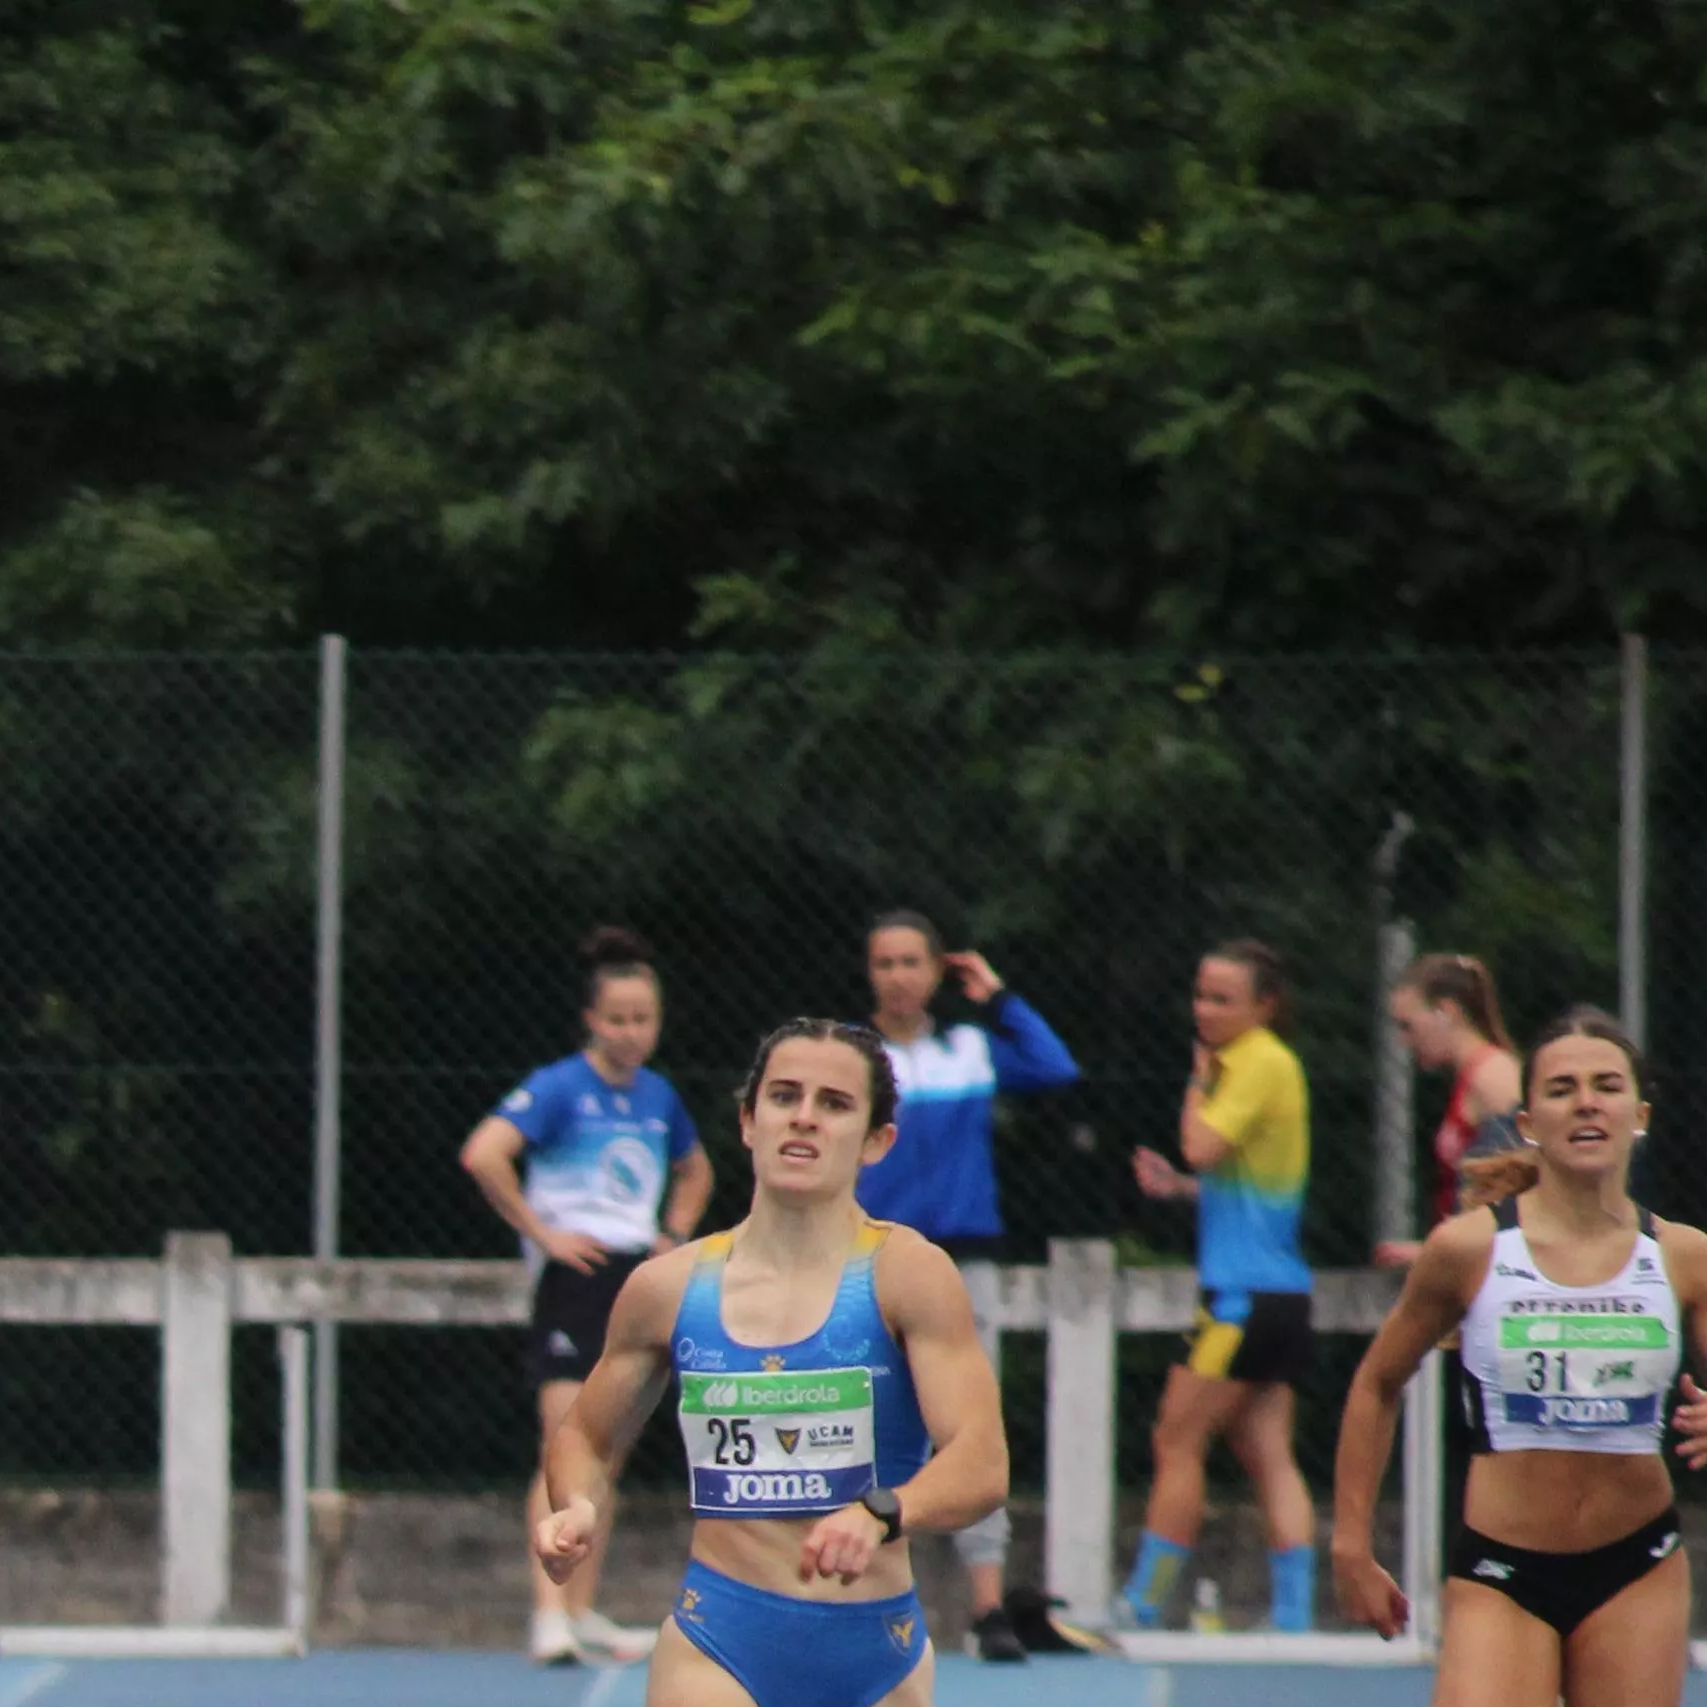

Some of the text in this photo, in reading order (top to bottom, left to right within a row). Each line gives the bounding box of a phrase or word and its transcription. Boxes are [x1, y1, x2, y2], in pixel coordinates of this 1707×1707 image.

[1526, 1351, 1567, 1392] 31
[743, 1384, 840, 1405] Iberdrola
[707, 1417, 756, 1466] 25
[807, 1425, 854, 1441] UCAM
[723, 1472, 833, 1505] Joma
